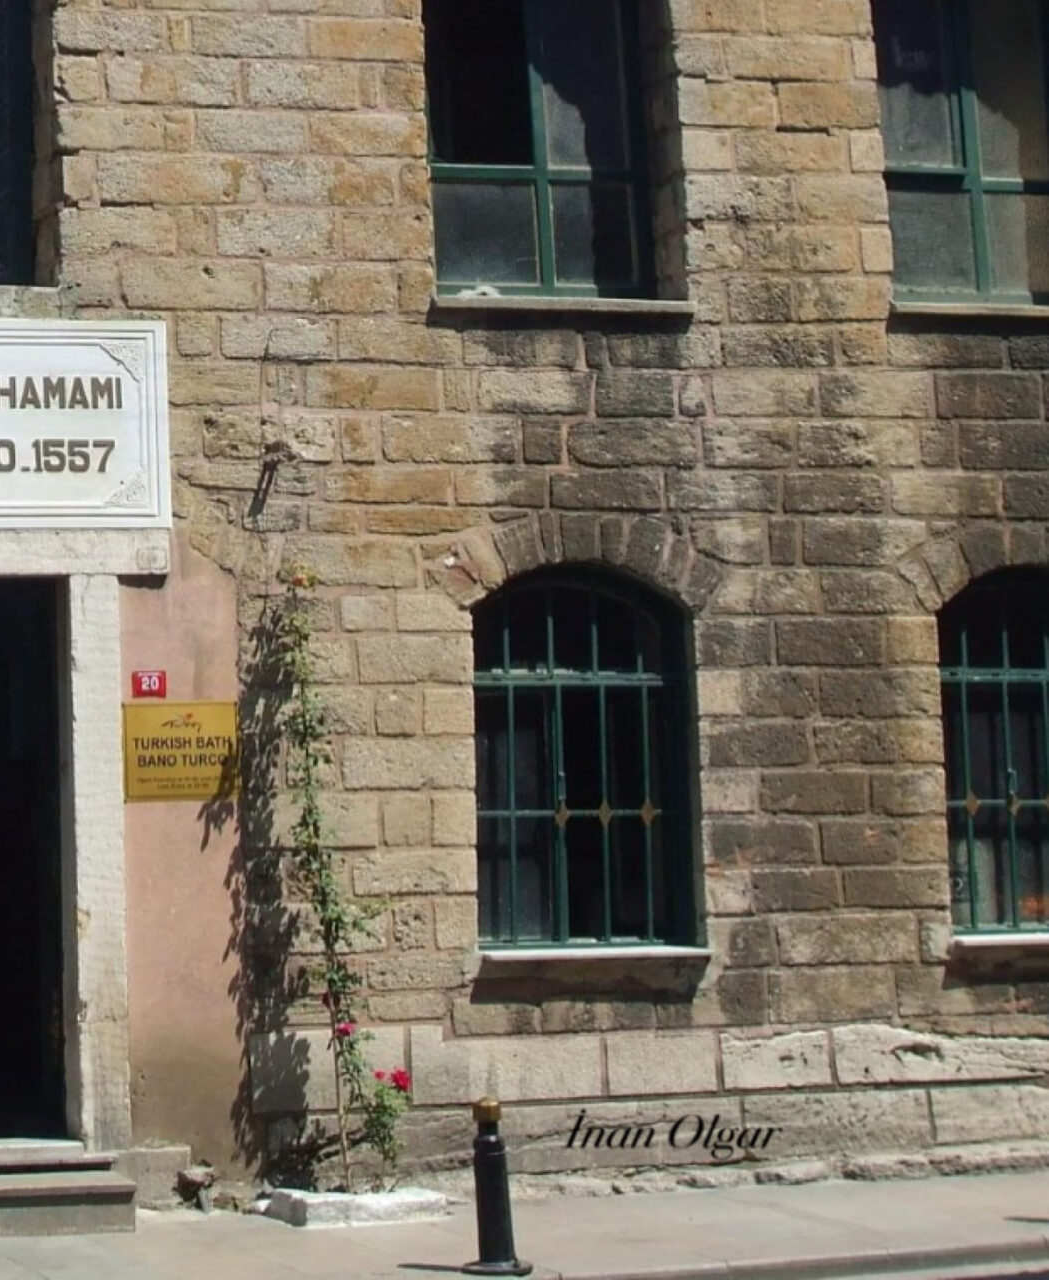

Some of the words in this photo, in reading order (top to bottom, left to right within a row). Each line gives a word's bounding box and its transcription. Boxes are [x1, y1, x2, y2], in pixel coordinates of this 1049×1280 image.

[141, 676, 160, 691] 20
[133, 736, 192, 751] TURKISH
[196, 735, 232, 750] BATH
[182, 753, 228, 767] TURCO
